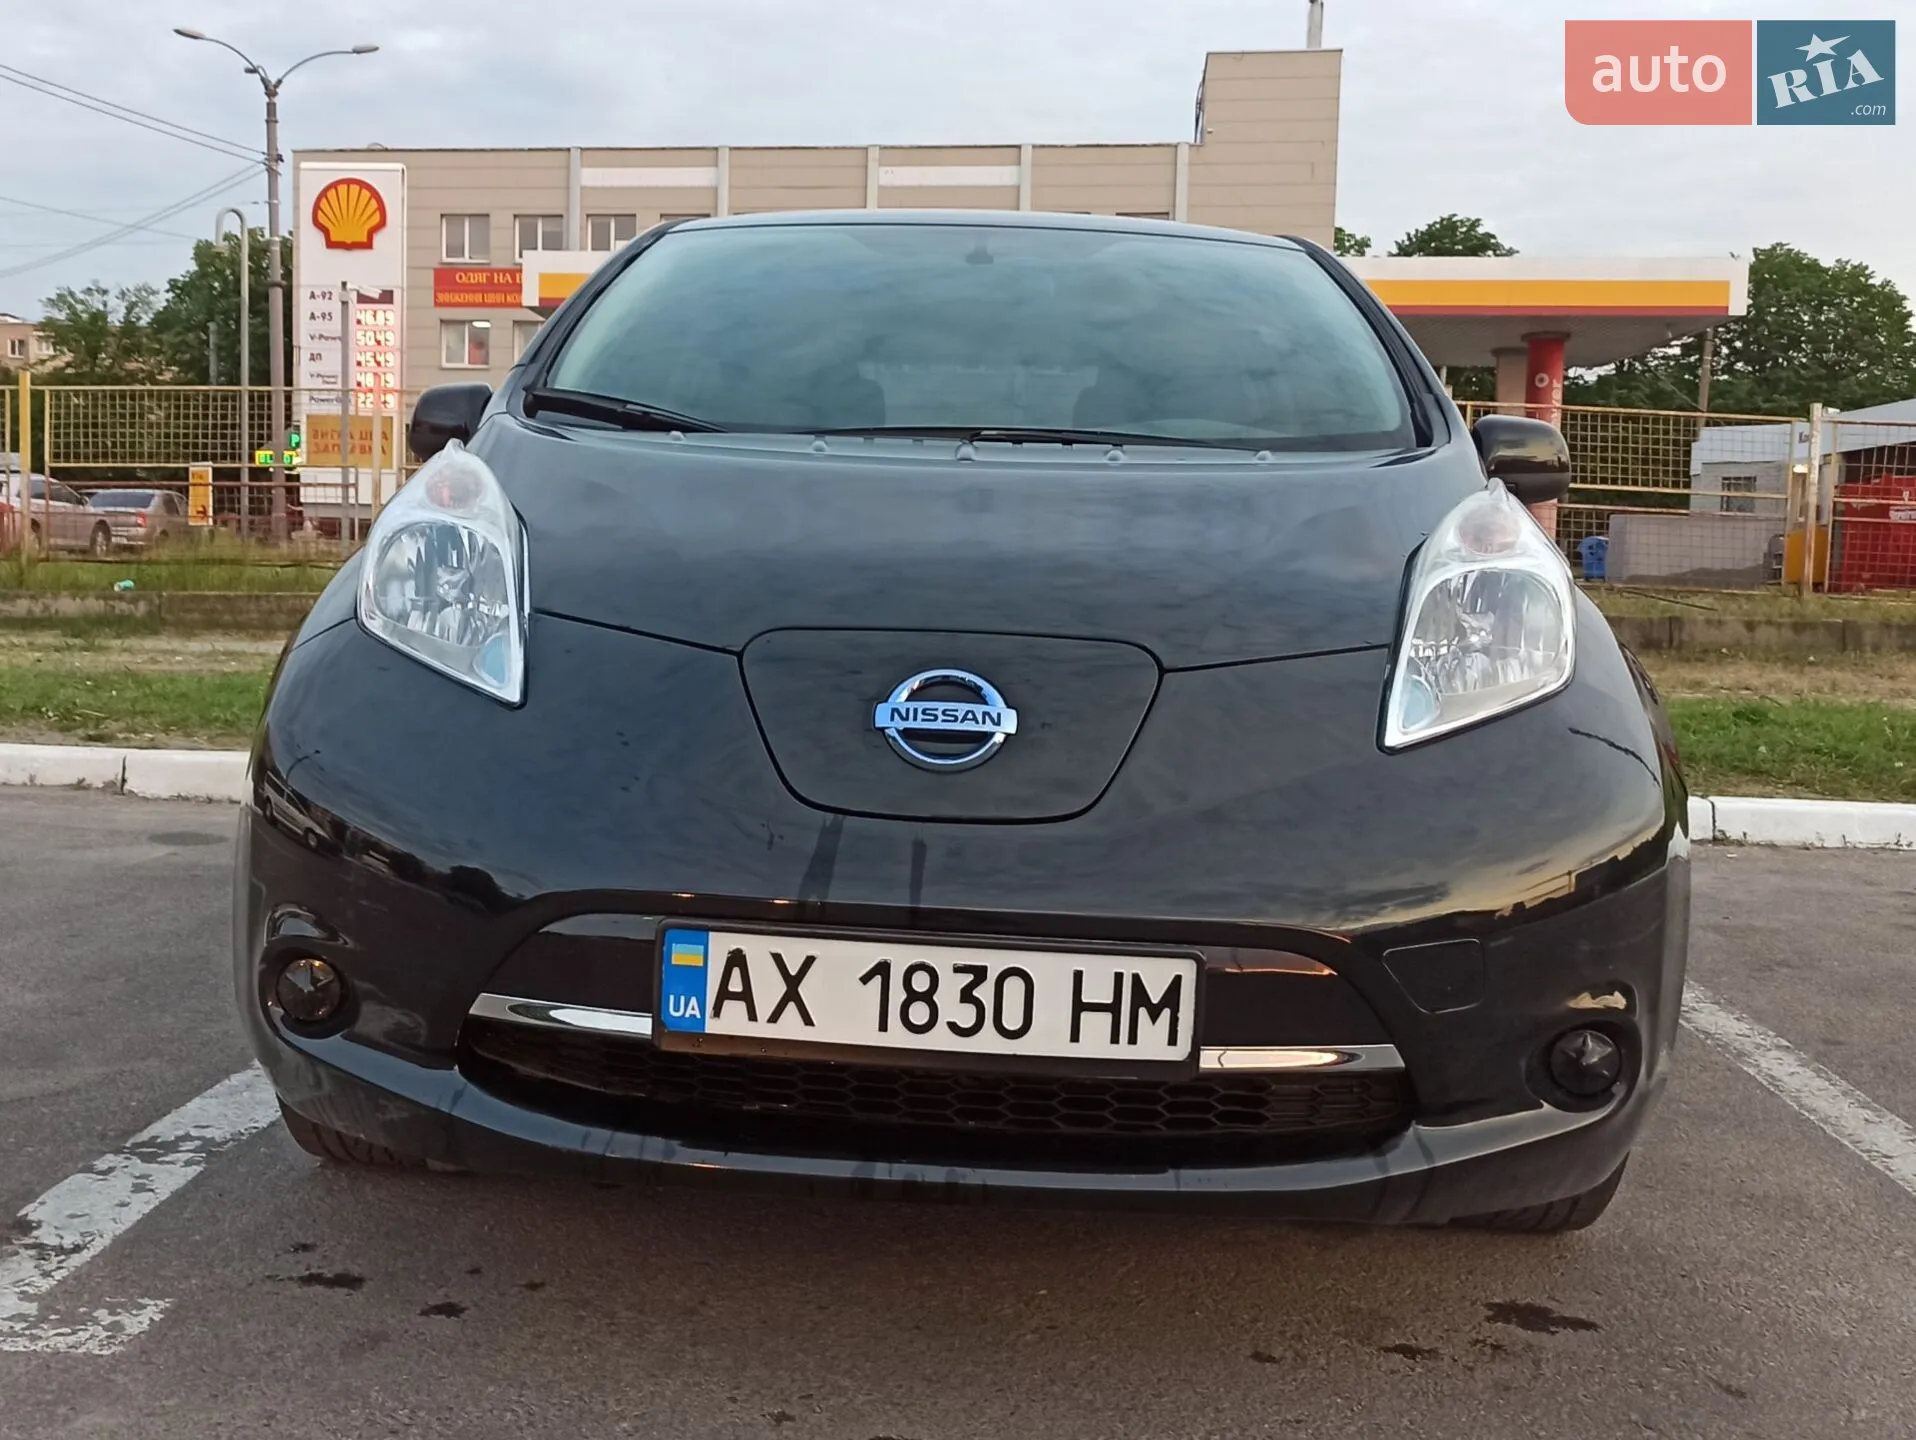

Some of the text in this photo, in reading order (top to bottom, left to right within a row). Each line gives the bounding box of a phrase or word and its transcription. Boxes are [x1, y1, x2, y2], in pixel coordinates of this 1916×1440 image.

[889, 707, 1001, 727] NISSAN
[668, 993, 701, 1019] UA
[710, 946, 1183, 1047] AX 1830 HM
